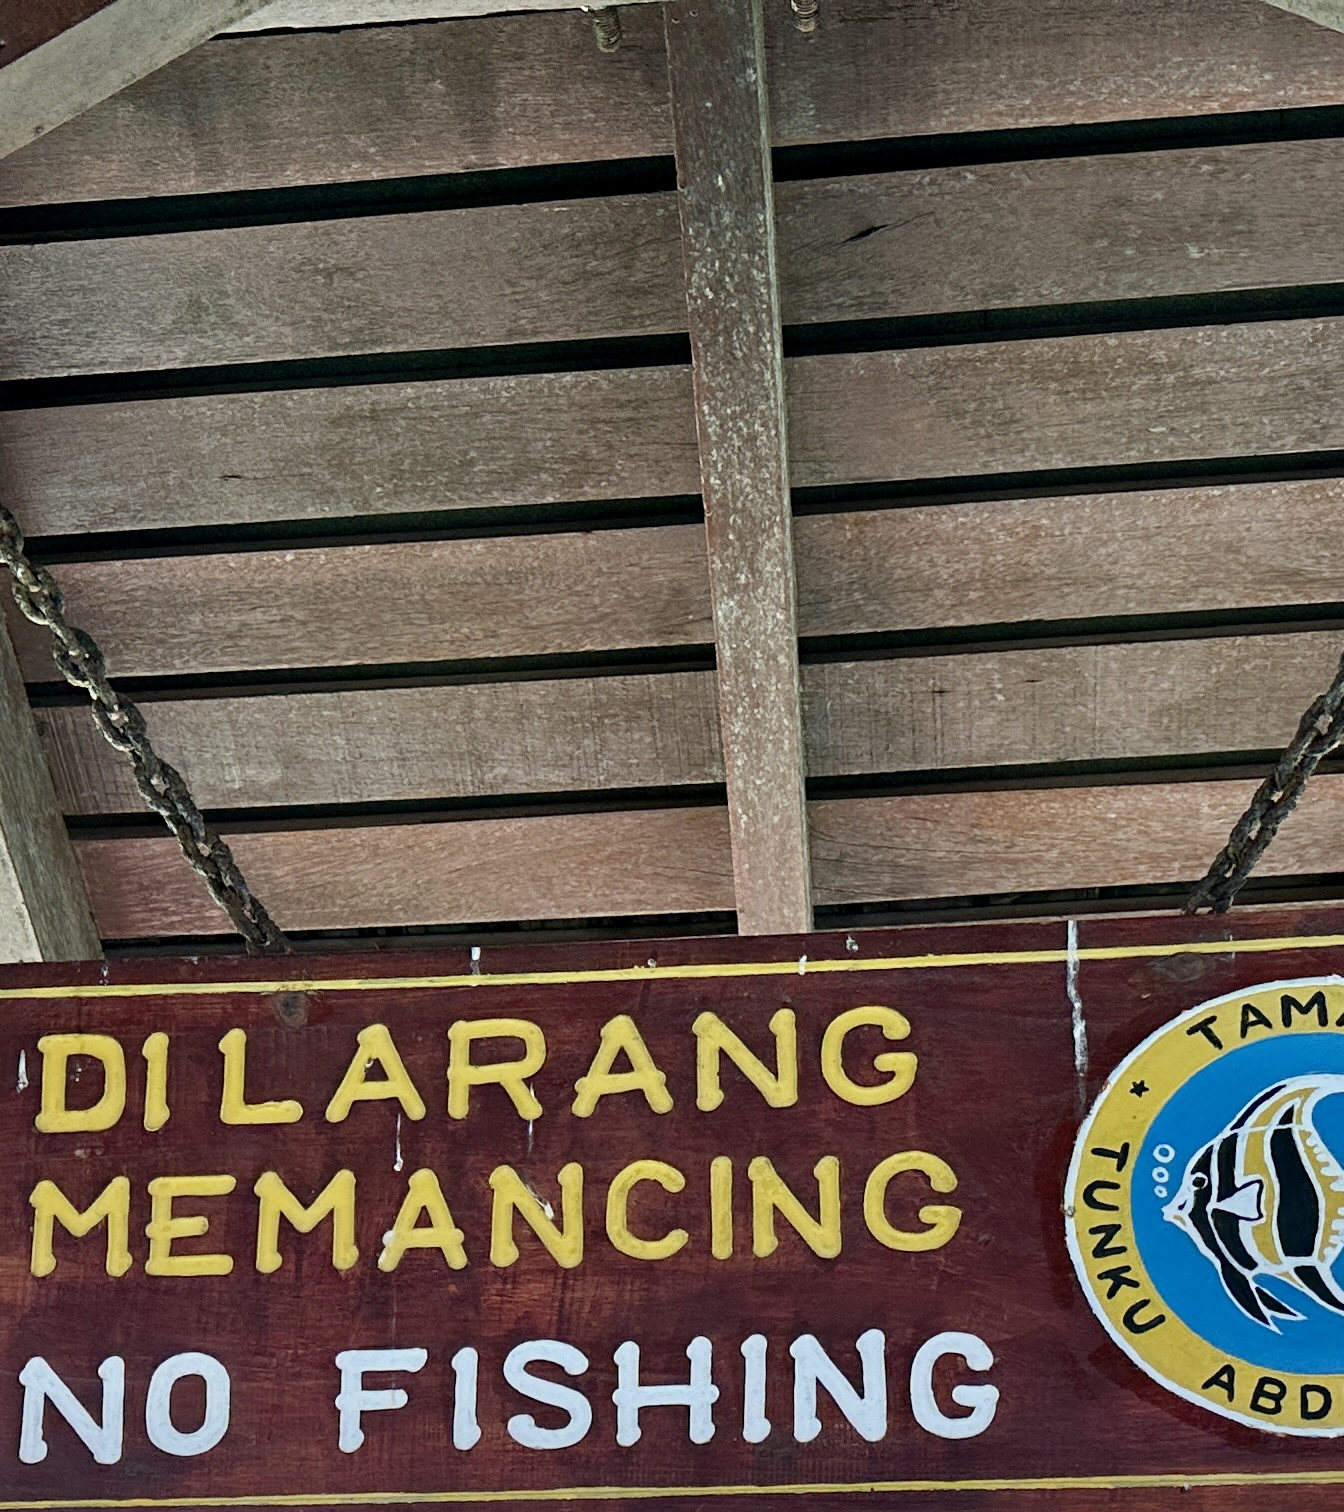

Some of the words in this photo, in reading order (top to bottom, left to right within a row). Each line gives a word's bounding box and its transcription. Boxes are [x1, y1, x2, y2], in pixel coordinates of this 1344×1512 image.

[29, 1150, 963, 1278] MEMANCING
[1082, 1142, 1166, 1335] TUNKU
[18, 1351, 233, 1465] NO
[334, 1328, 1000, 1453] FISHING
